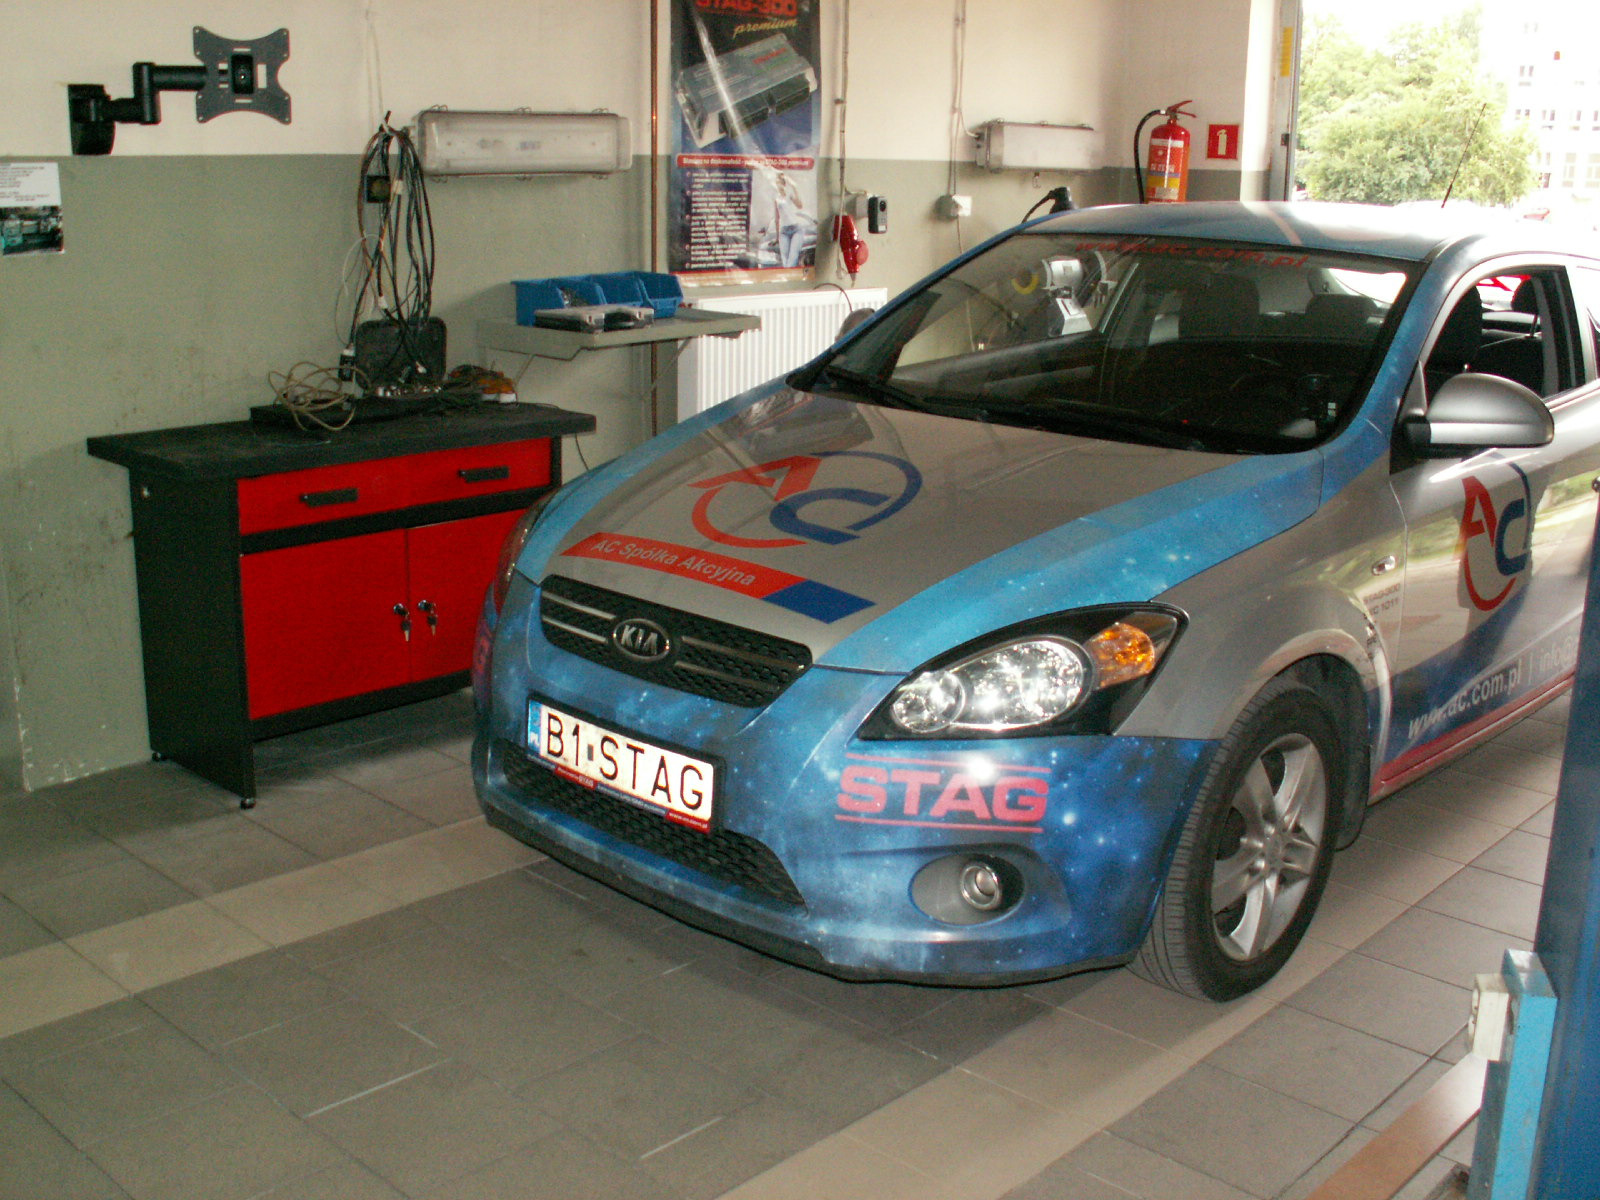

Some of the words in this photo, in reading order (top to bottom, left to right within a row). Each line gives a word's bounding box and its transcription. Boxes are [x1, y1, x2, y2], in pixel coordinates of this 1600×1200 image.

[732, 18, 798, 39] premium
[590, 539, 621, 554] AC
[677, 556, 757, 586] Akcyjna
[619, 625, 658, 656] KIA
[599, 736, 704, 811] STAG
[836, 764, 1049, 823] STAG
